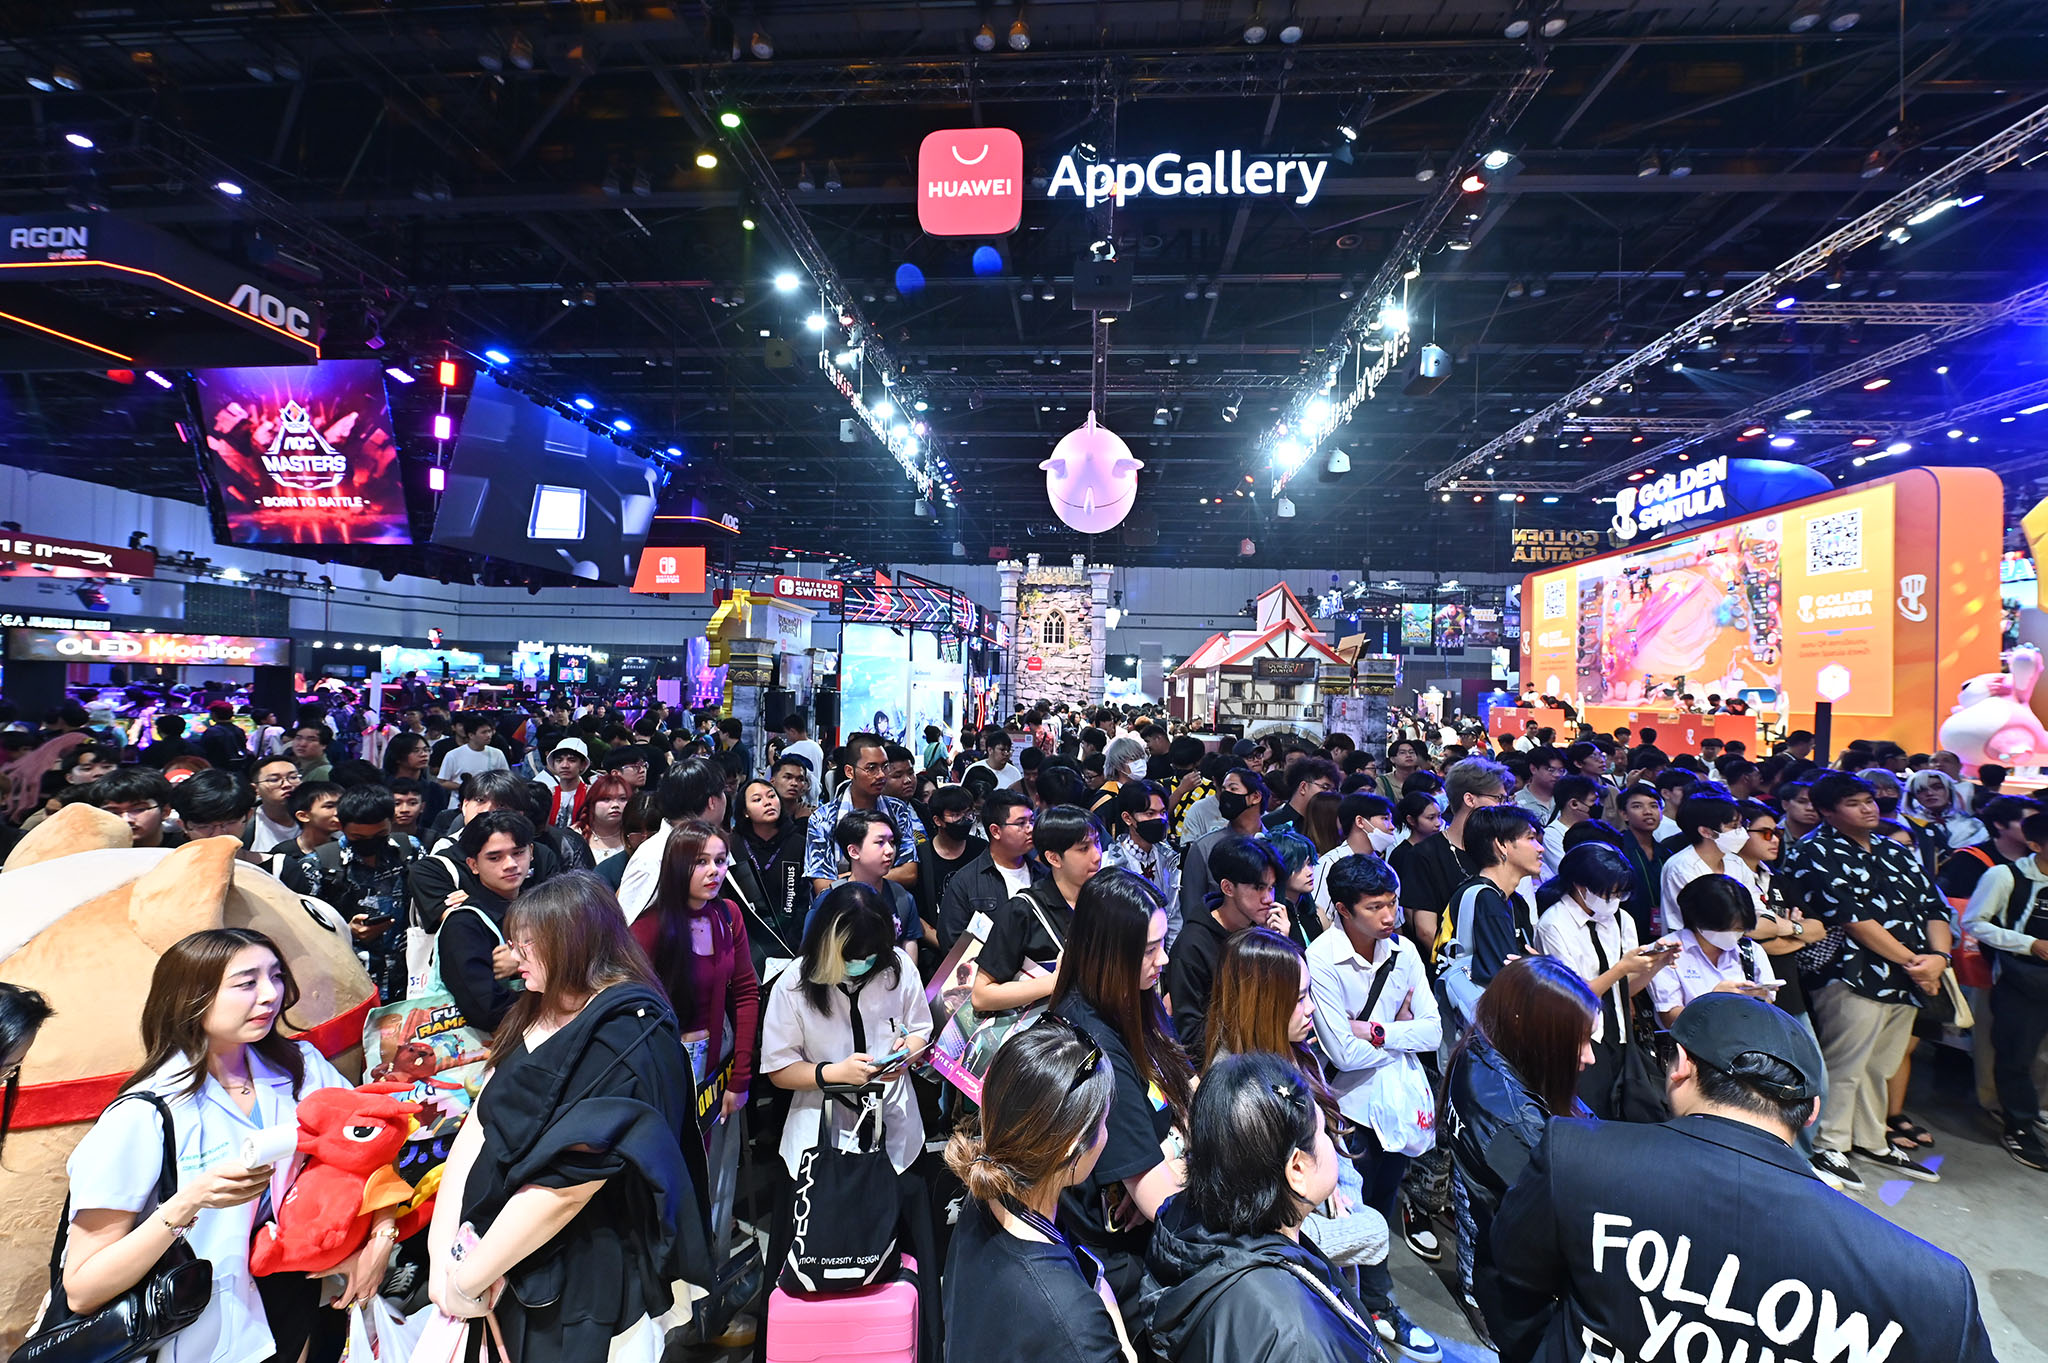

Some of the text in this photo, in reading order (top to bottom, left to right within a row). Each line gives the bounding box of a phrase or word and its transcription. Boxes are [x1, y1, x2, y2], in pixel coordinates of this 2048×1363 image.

[928, 178, 1012, 198] HUAWEI
[1047, 149, 1328, 208] AppGallery
[10, 226, 88, 249] AGON
[228, 283, 311, 338] AOC
[283, 436, 316, 450] AOC
[261, 455, 347, 473] MASTERS
[1638, 455, 1728, 507] GOLDEN
[262, 496, 363, 508] BORN TO BATTLE
[1638, 484, 1727, 531] SPATULA
[795, 580, 839, 590] NINTENDO
[795, 587, 839, 599] SWITCH
[1815, 589, 1873, 608] GOLDEN
[1815, 602, 1873, 620] SPATULA
[56, 637, 256, 661] OLED Monitor
[821, 1256, 853, 1265] DIVERSITY
[856, 1254, 880, 1265] DESIGN
[1593, 1212, 1904, 1363] FOLLOW
